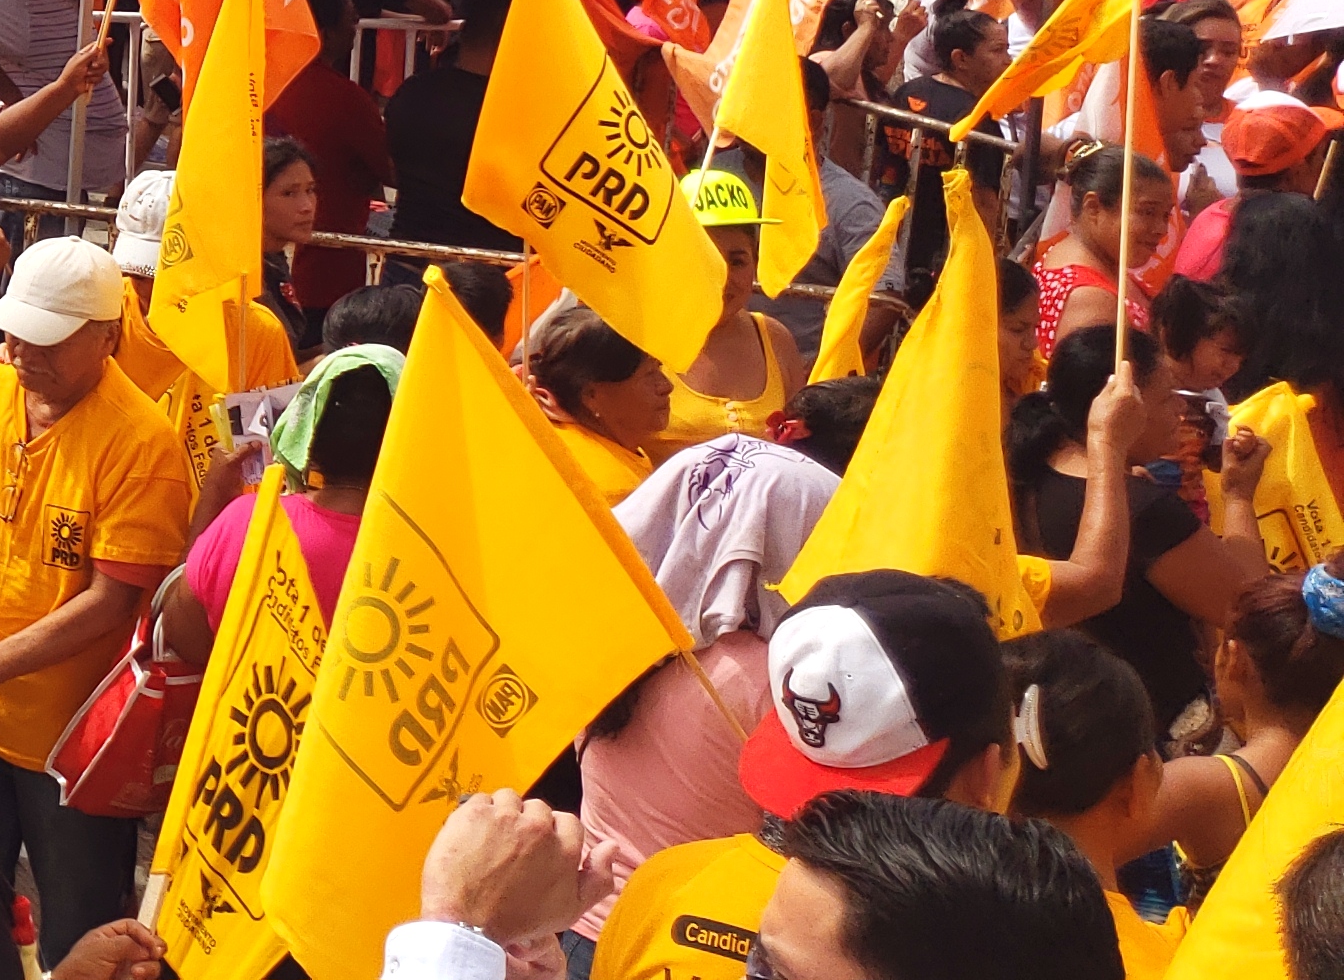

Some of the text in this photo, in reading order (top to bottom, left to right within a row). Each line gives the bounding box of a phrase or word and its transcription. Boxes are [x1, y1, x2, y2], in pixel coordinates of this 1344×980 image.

[529, 191, 556, 217] PAN
[563, 150, 650, 221] PRD
[695, 178, 748, 212] JACKO
[1295, 505, 1321, 559] Candidato
[51, 546, 81, 568] PRD
[192, 757, 266, 875] PRD
[684, 922, 753, 960] Candid
